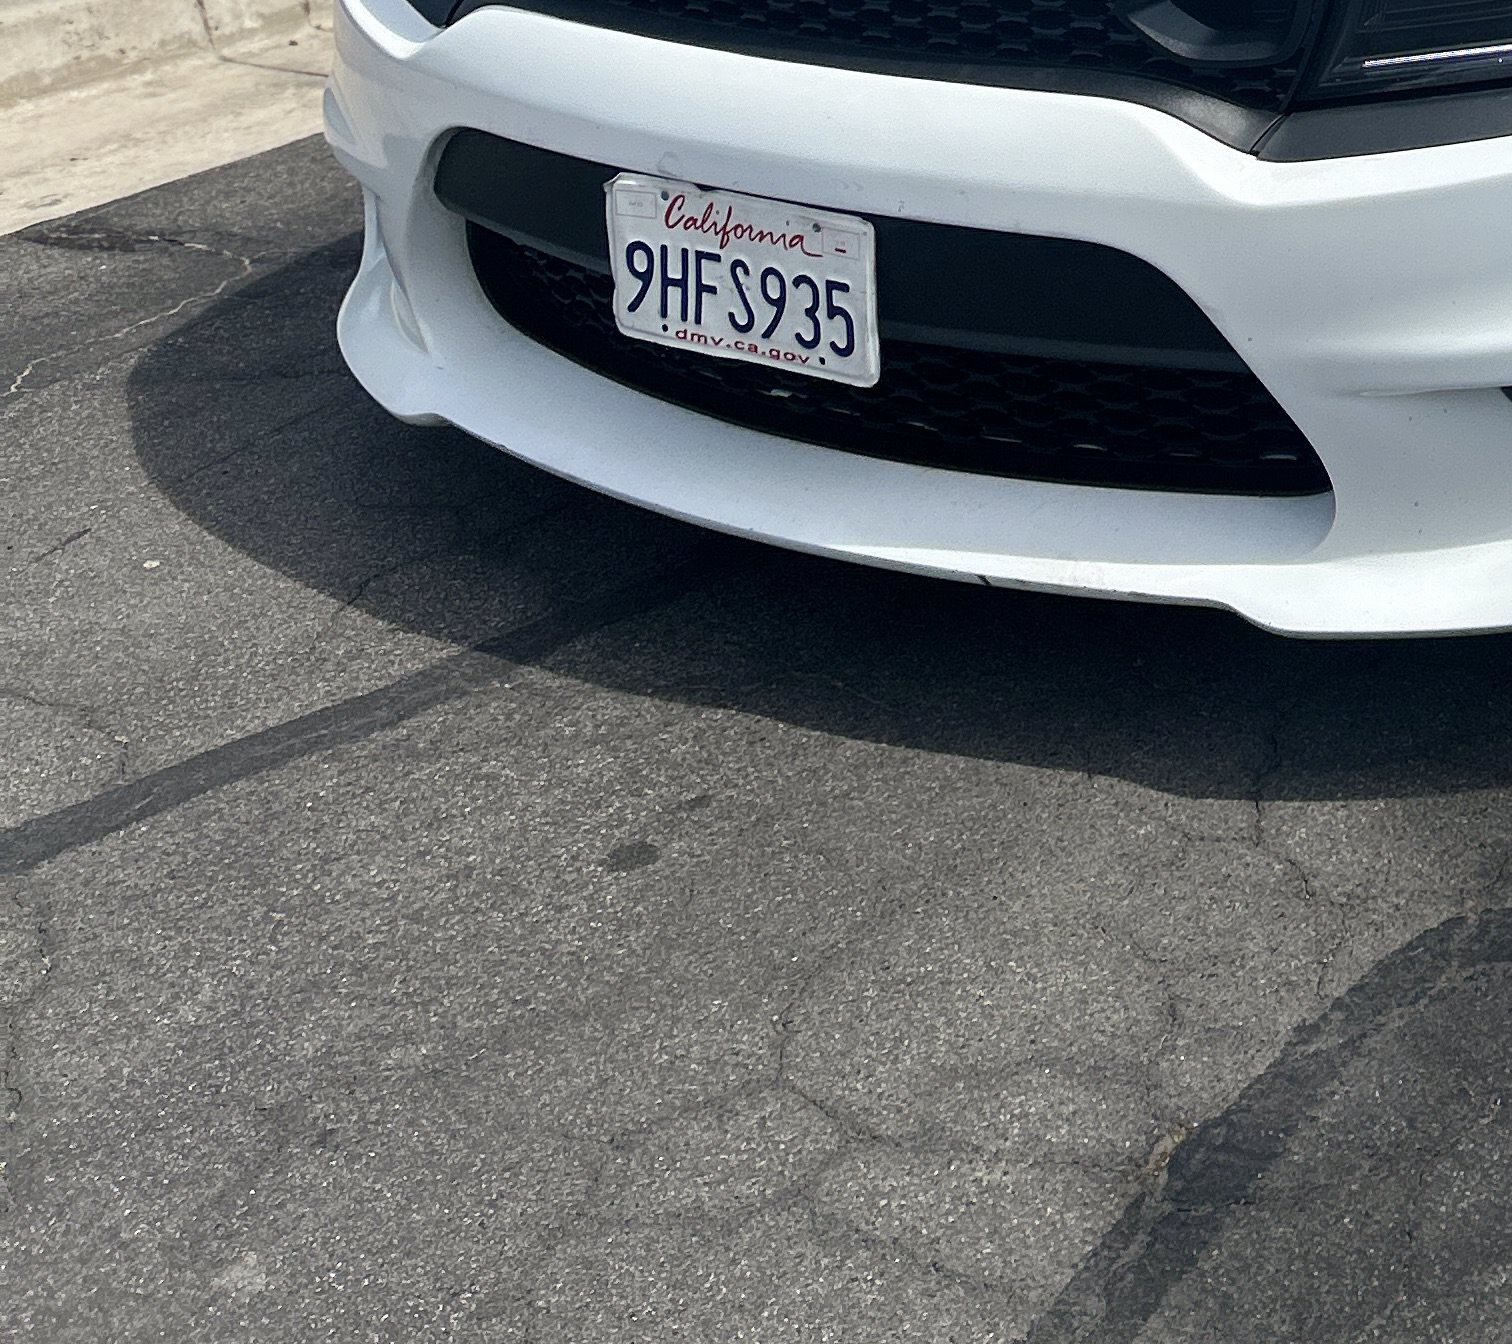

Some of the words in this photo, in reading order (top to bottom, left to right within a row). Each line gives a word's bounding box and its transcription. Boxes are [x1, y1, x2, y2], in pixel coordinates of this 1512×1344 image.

[664, 194, 823, 257] California
[625, 240, 855, 358] 9HFS935
[675, 328, 810, 365] dmv.ca.gov
